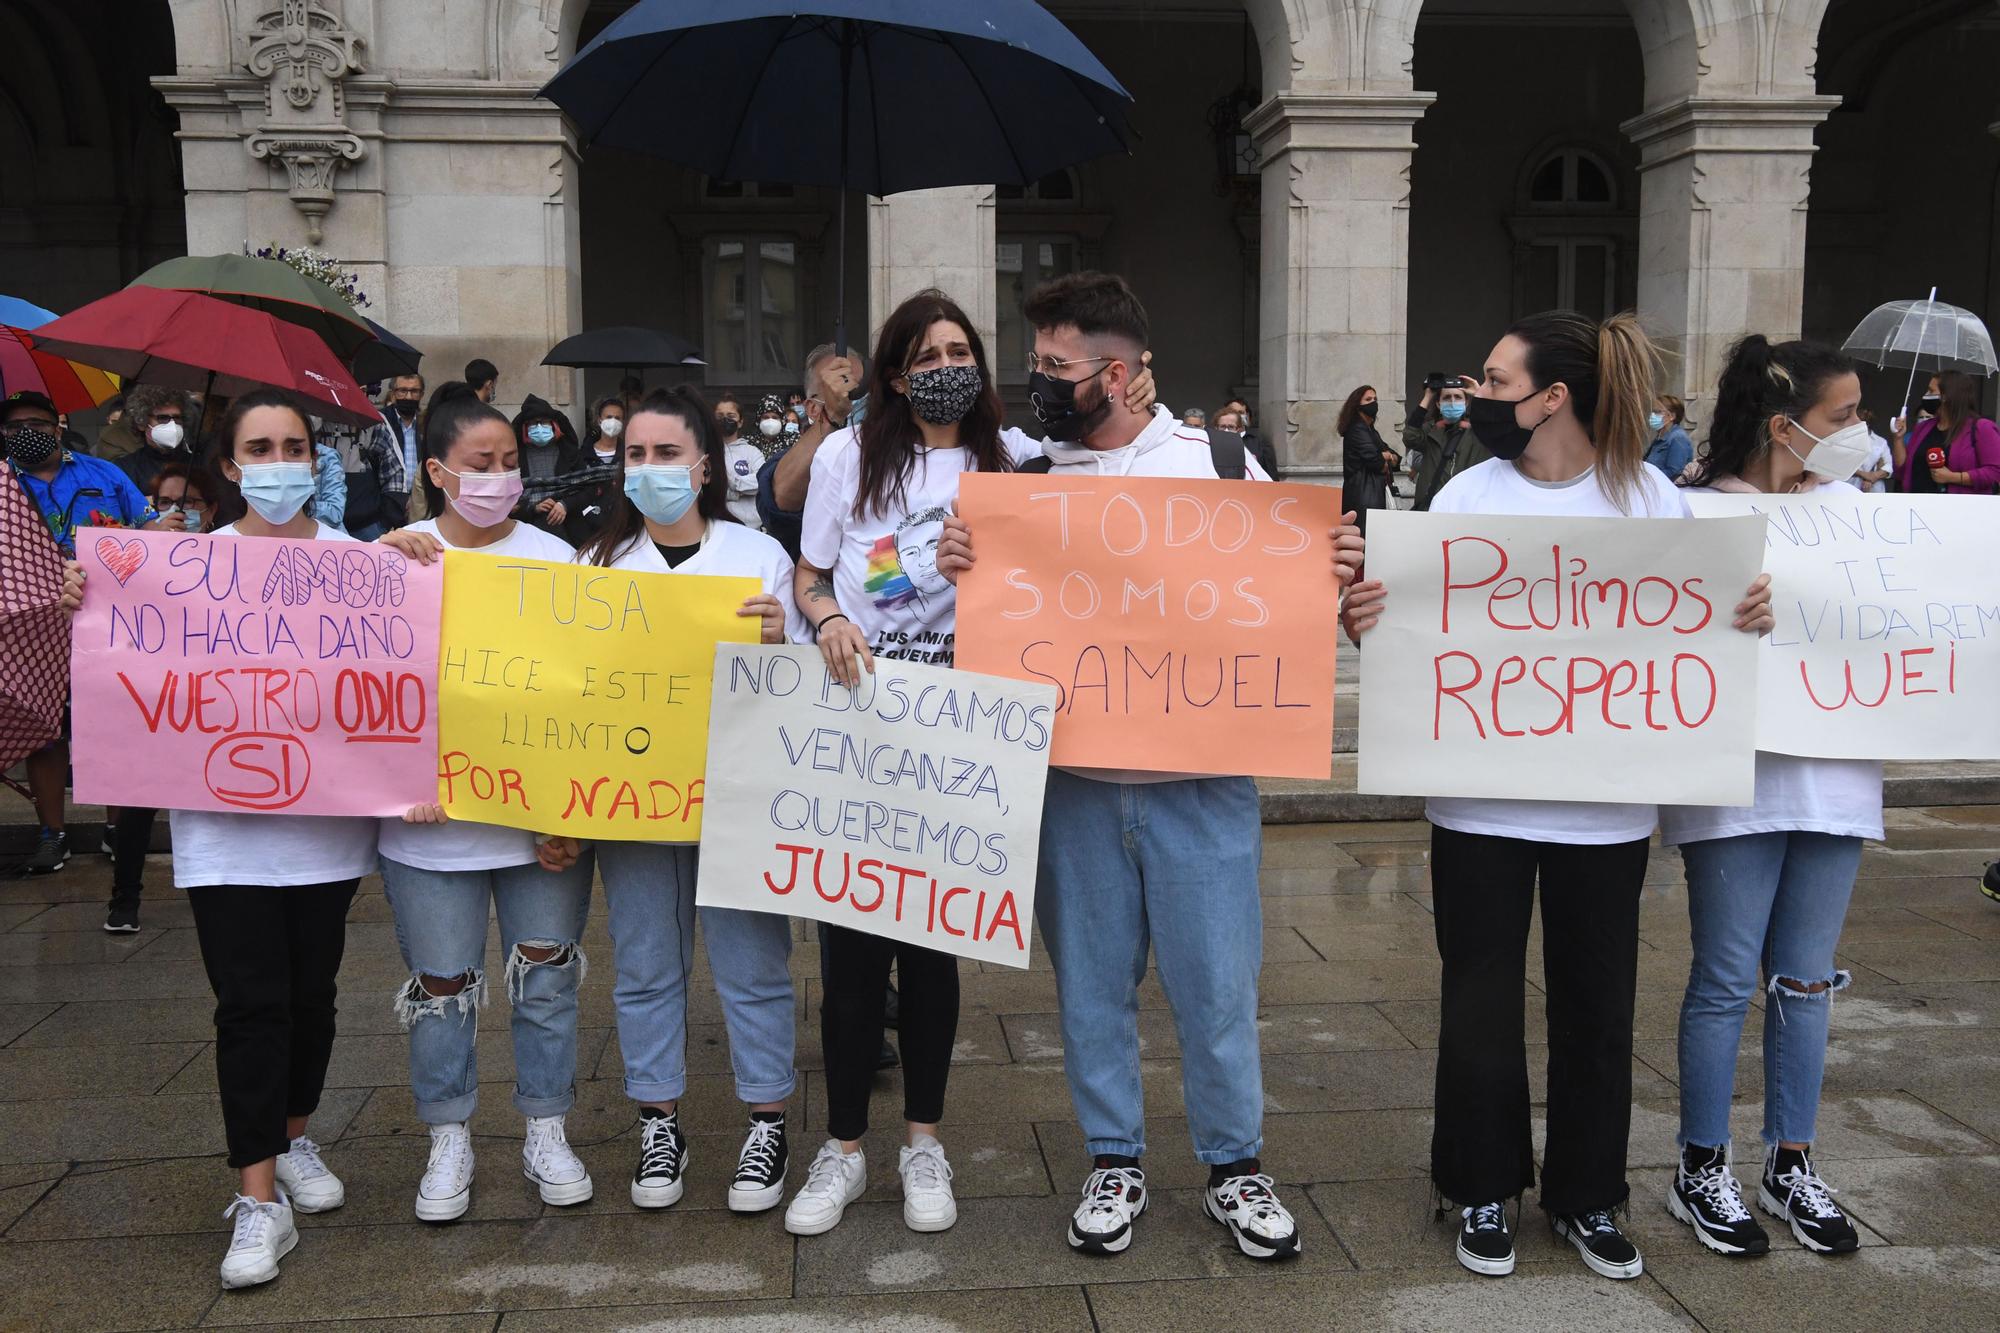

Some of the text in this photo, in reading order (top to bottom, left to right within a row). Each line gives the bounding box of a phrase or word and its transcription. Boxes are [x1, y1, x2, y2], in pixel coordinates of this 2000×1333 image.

[1029, 492, 1311, 556] TODOS
[1752, 505, 1942, 547] NUNCA
[165, 538, 407, 608] SU AMOR
[497, 566, 650, 633] TUSA
[1000, 568, 1269, 627] SOMOS
[1441, 536, 1713, 634] Pedimos
[1835, 556, 1917, 596] TE
[110, 604, 414, 659] NO HACÍA DAÑO
[878, 631, 908, 644] TUS
[117, 668, 426, 734] VUESTRO ODIO
[445, 646, 691, 704] HICE ESTE
[731, 655, 801, 696] NO
[1021, 641, 1311, 715] SAMUEL
[501, 712, 651, 754] LLANTO
[216, 743, 292, 798] SI
[438, 751, 530, 811] POR
[779, 725, 1009, 816] VENGANZA,
[770, 790, 1008, 876] QUEREMOS
[764, 843, 1025, 950] JUSTICIA
